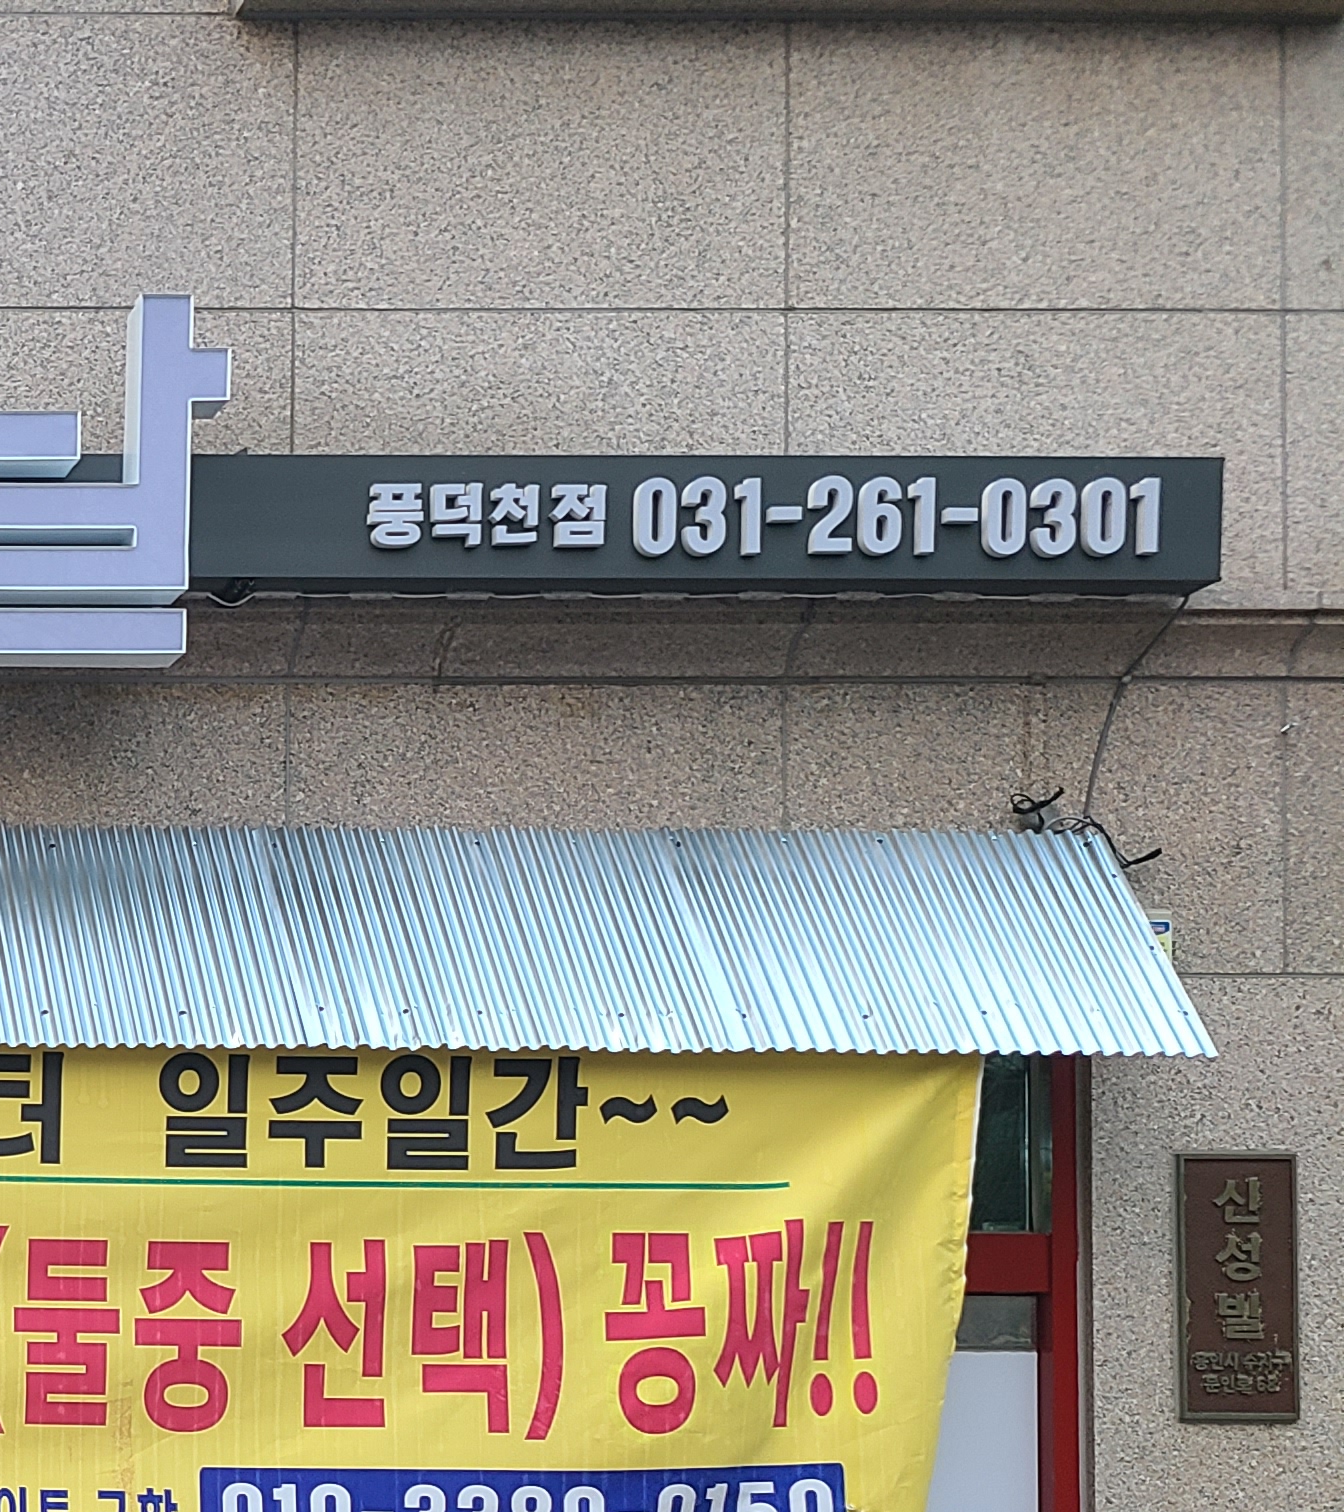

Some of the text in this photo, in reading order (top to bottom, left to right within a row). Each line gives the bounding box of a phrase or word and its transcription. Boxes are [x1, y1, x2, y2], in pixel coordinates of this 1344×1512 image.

[366, 475, 1163, 560] 풍덕천점 031-261-0301
[281, 1231, 565, 1441] 선택)
[604, 1219, 879, 1436] 꽁짜!!
[1212, 1175, 1266, 1341] 신성빌
